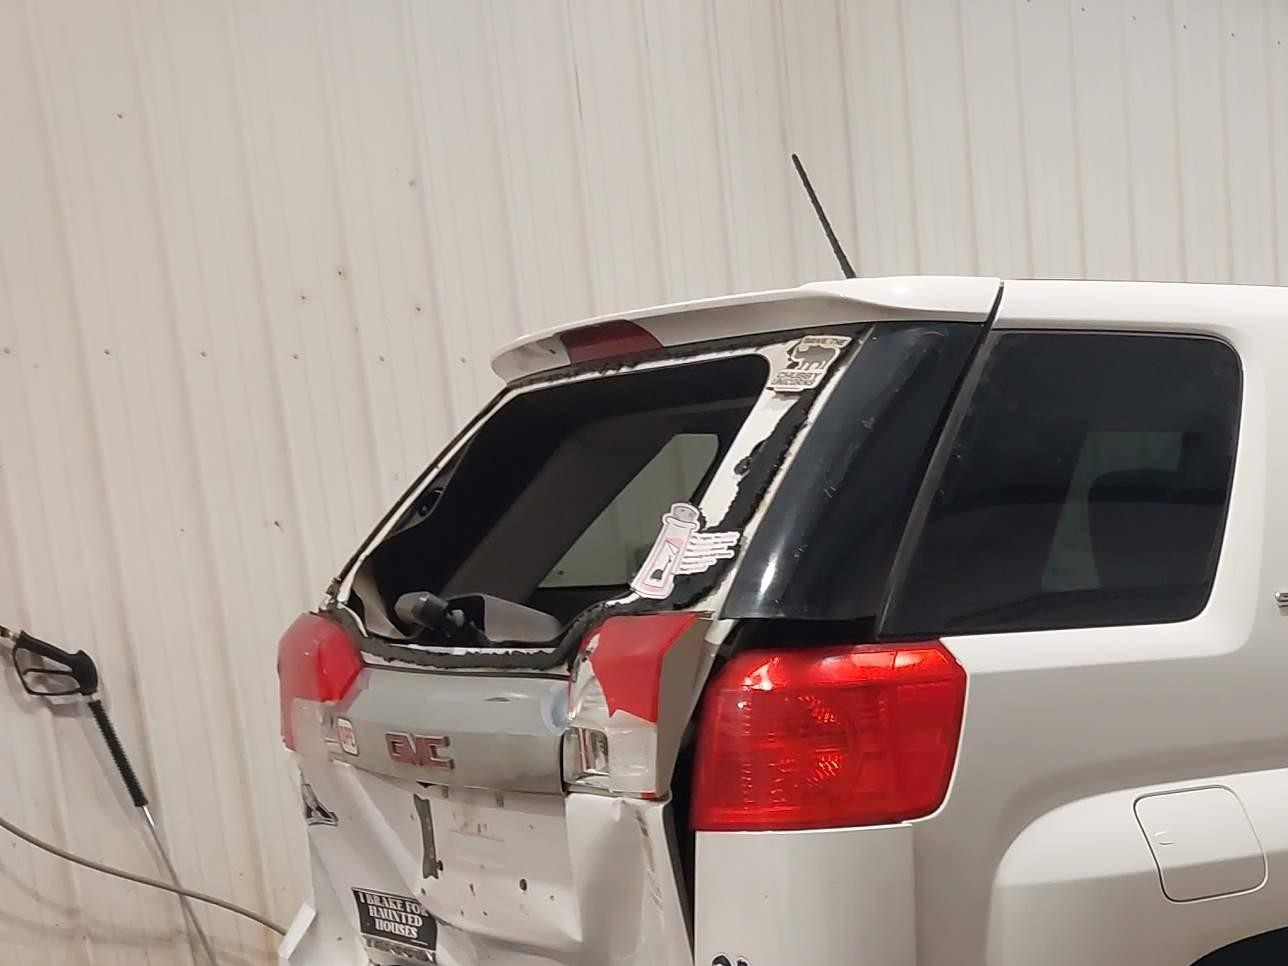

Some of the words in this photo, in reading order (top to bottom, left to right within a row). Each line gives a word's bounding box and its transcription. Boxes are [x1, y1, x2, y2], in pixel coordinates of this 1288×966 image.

[384, 731, 455, 770] GMC
[365, 893, 405, 911] BRAKE
[368, 904, 423, 927] HAUNTED
[374, 918, 418, 939] HOUSES
